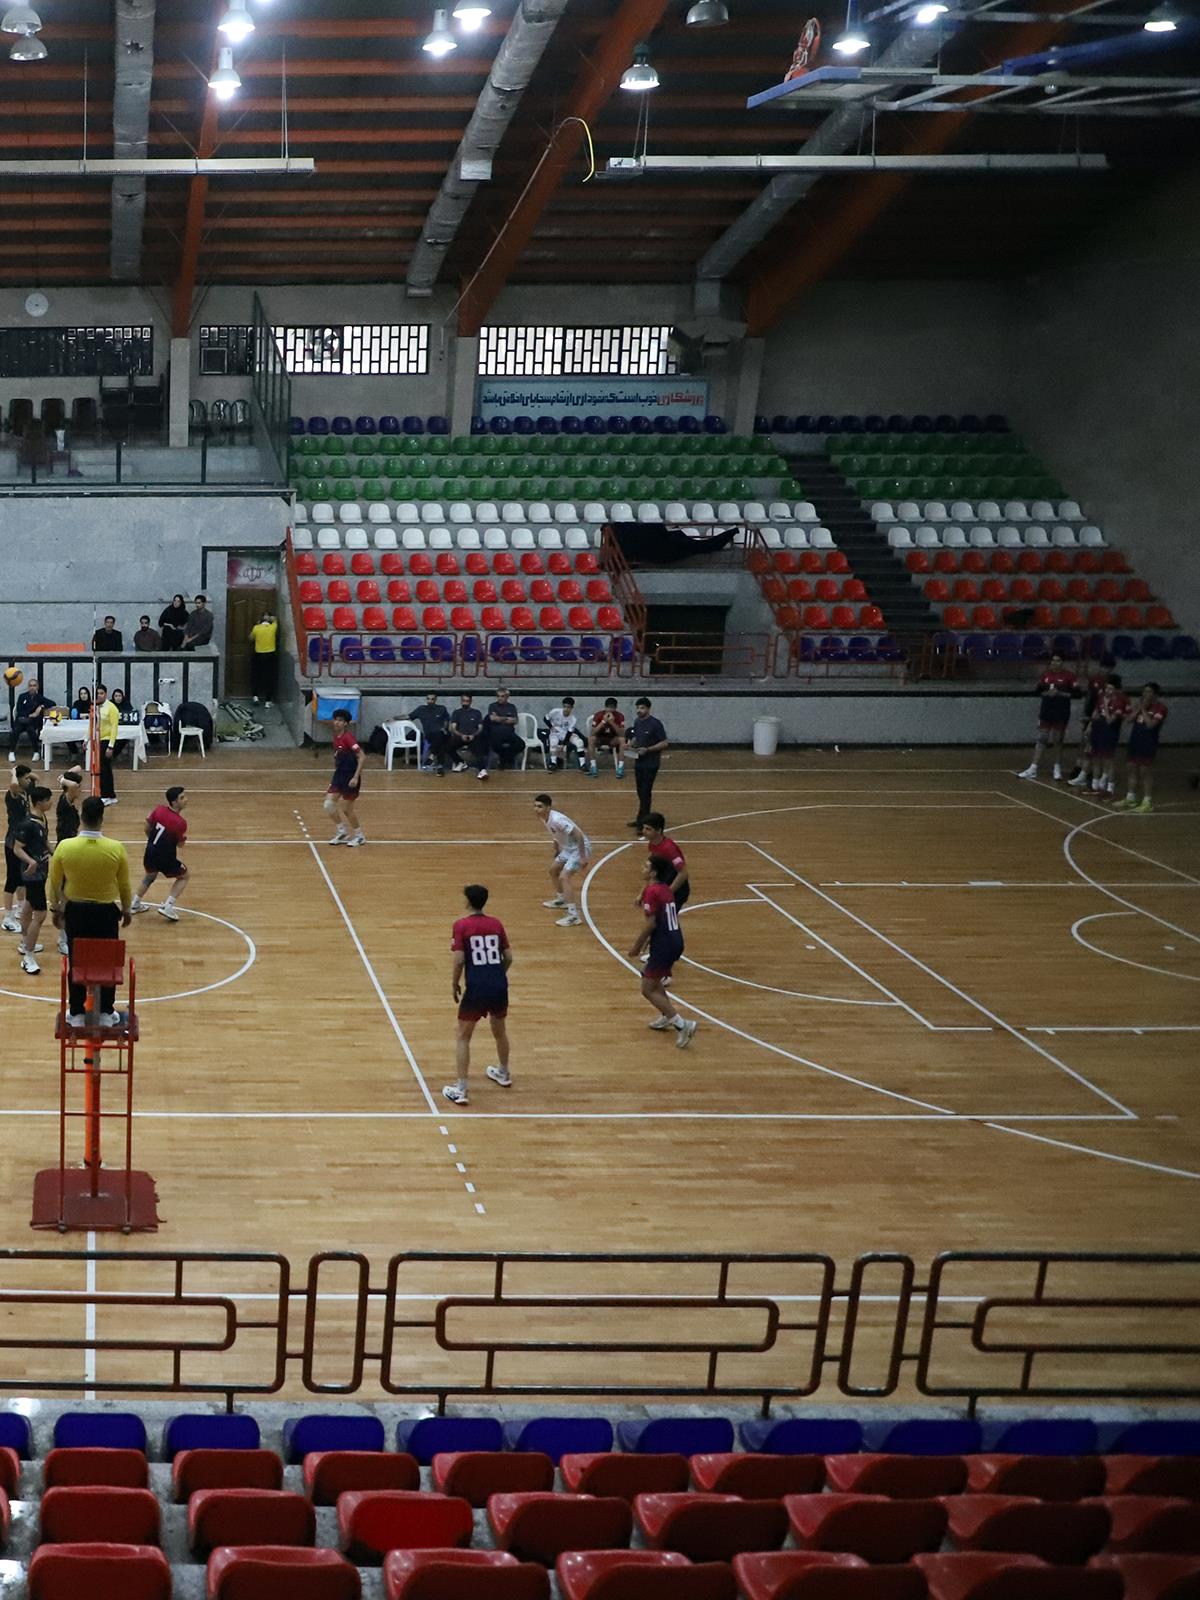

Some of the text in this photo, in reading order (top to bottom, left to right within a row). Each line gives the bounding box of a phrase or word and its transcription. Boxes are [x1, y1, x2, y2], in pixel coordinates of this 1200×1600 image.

[129, 712, 138, 722] 14
[153, 822, 166, 845] 7
[665, 901, 679, 931] 10
[469, 934, 501, 966] 88
